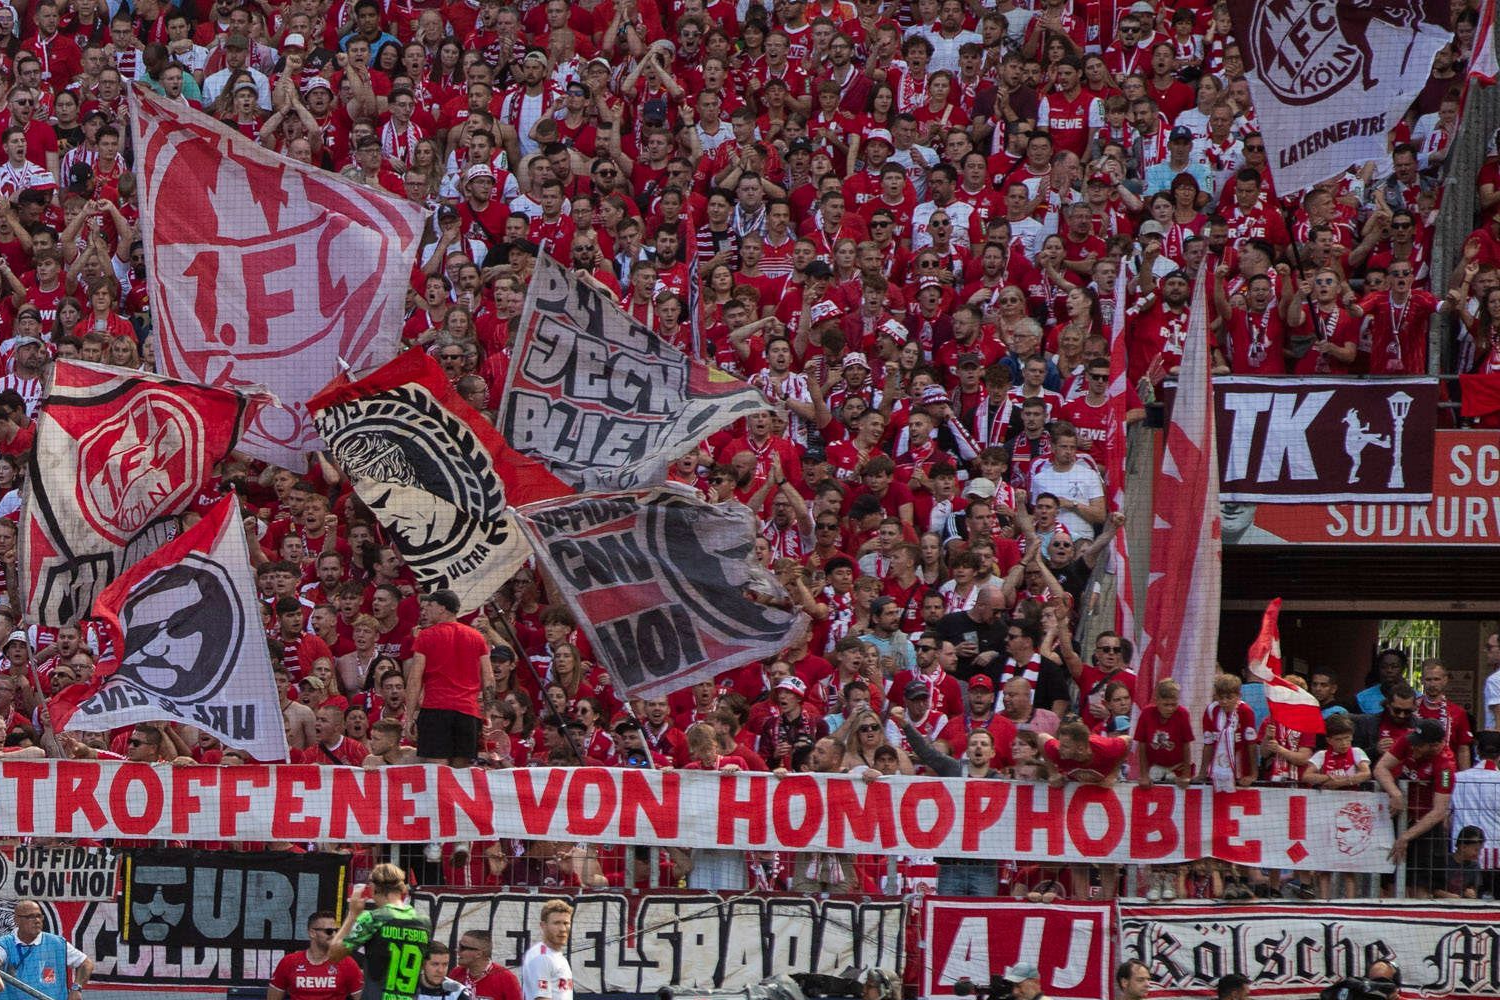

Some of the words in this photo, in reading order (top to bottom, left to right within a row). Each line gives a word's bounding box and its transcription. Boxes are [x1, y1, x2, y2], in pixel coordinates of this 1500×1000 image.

[1300, 43, 1358, 95] KÖLN
[1050, 118, 1083, 130] REWE
[118, 479, 173, 532] KÖLN
[446, 542, 491, 581] ULTRA
[512, 768, 680, 840] VON
[14, 870, 64, 897] CON
[71, 871, 115, 897] NOI
[192, 867, 320, 941] URI
[386, 943, 425, 994] 19
[1122, 921, 1397, 989] Kölsche
[296, 976, 337, 989] REWE
